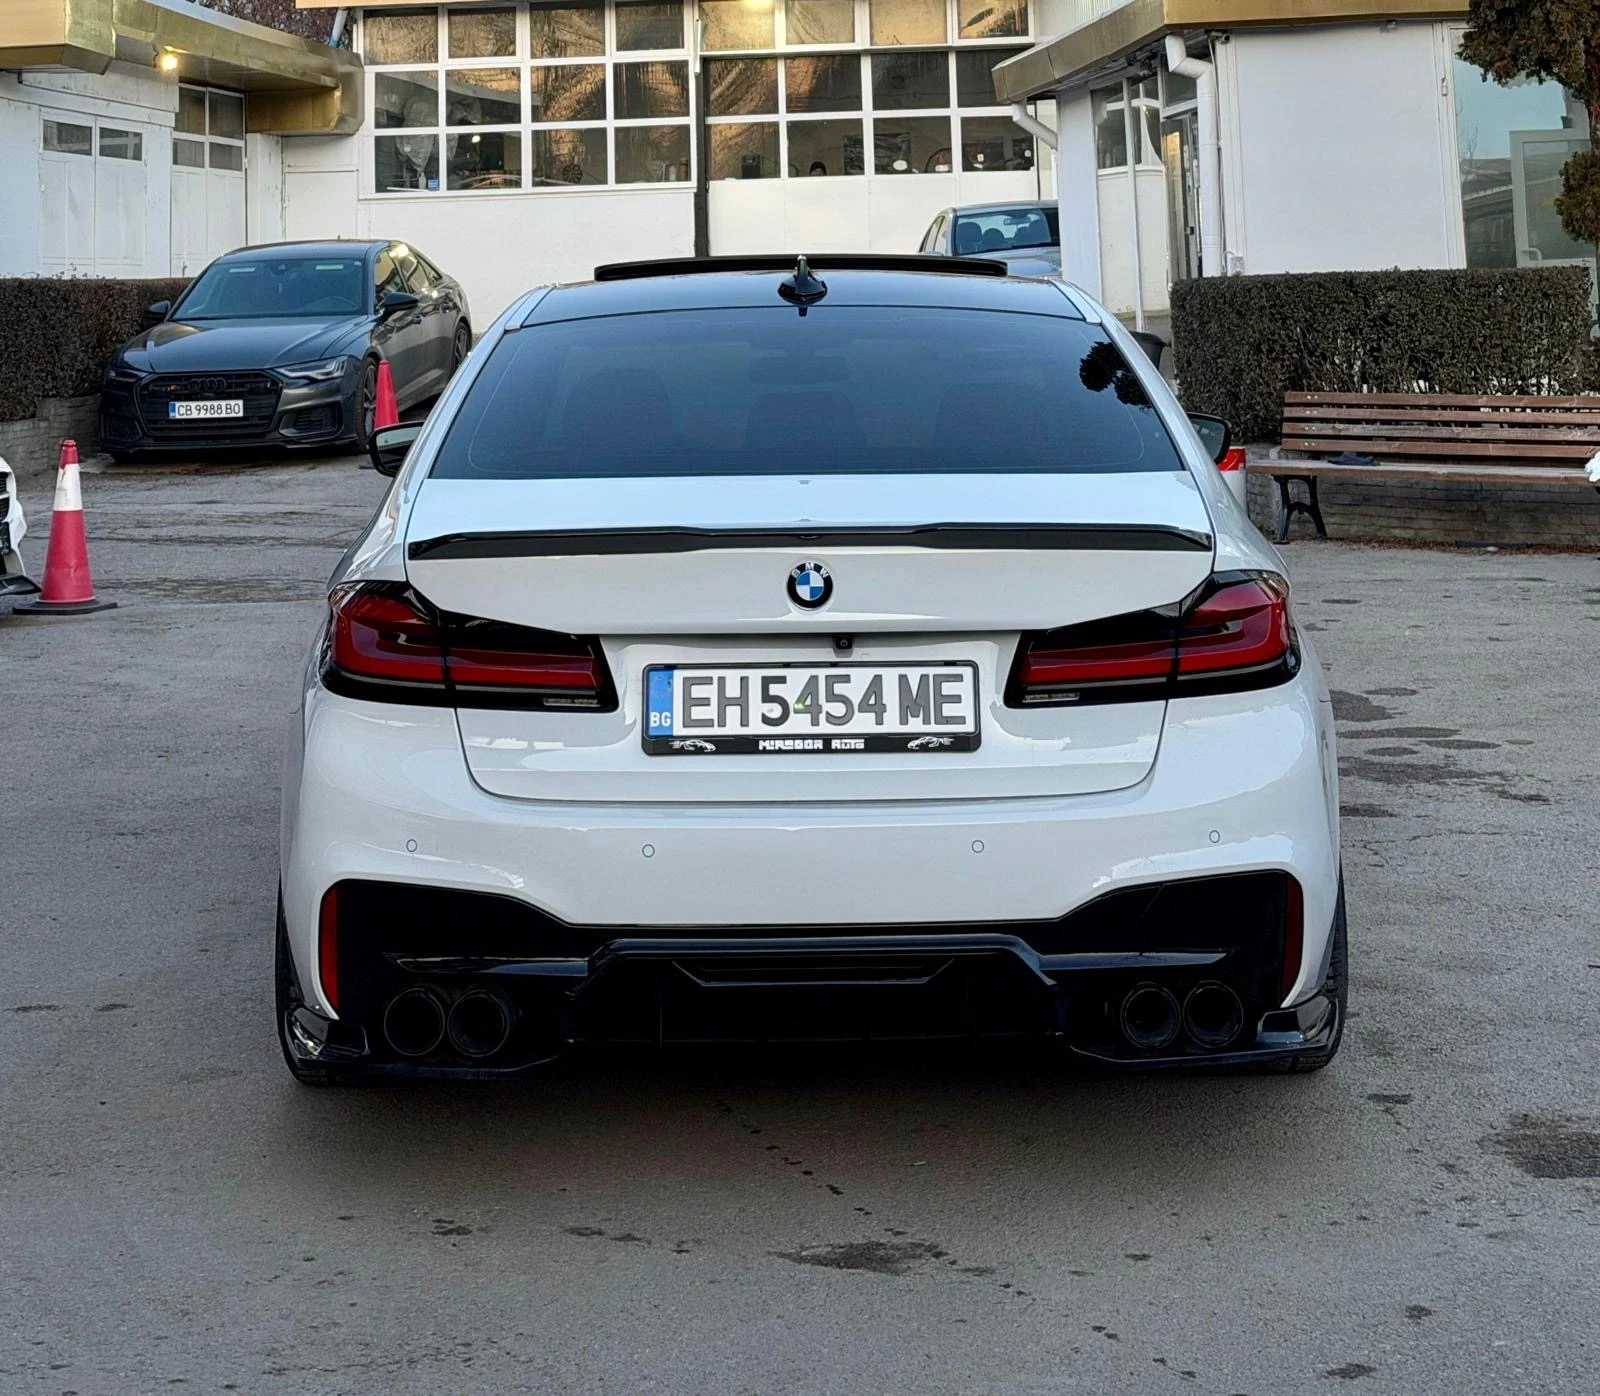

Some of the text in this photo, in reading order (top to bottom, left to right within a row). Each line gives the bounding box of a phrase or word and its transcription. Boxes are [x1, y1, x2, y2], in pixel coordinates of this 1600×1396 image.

[177, 405, 192, 416] CB
[195, 404, 223, 415] 9988
[791, 561, 829, 578] BMW
[682, 673, 967, 728] EH 5454 ME
[650, 711, 671, 727] BG
